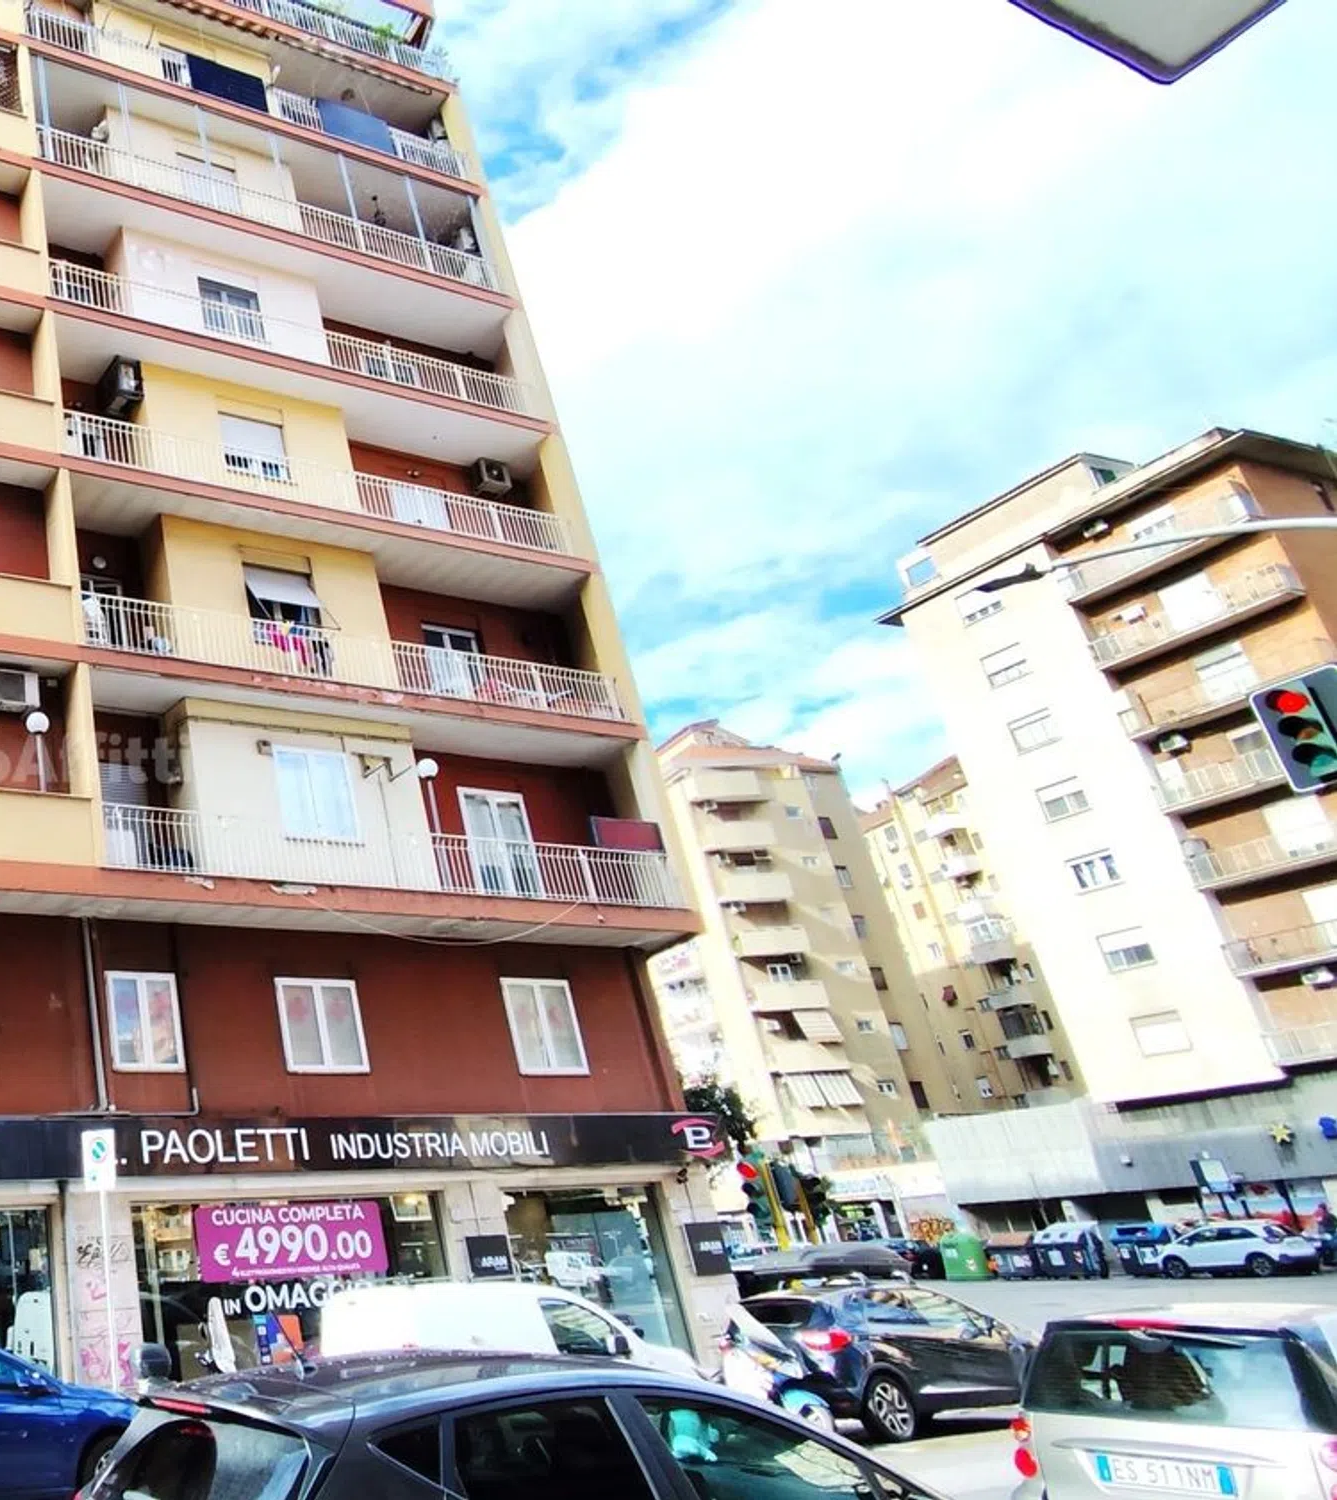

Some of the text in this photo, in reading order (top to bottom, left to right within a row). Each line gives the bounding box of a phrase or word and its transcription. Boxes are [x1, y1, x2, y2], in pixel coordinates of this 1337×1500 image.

[140, 1127, 551, 1165] PAOLETTI INDUSTRIA MOBILI
[211, 1204, 365, 1226] CUCINA COMPLETA
[213, 1223, 373, 1266] € 4990.00
[223, 1281, 373, 1315] IN OMAG
[1112, 1458, 1218, 1491] ES 511NM
